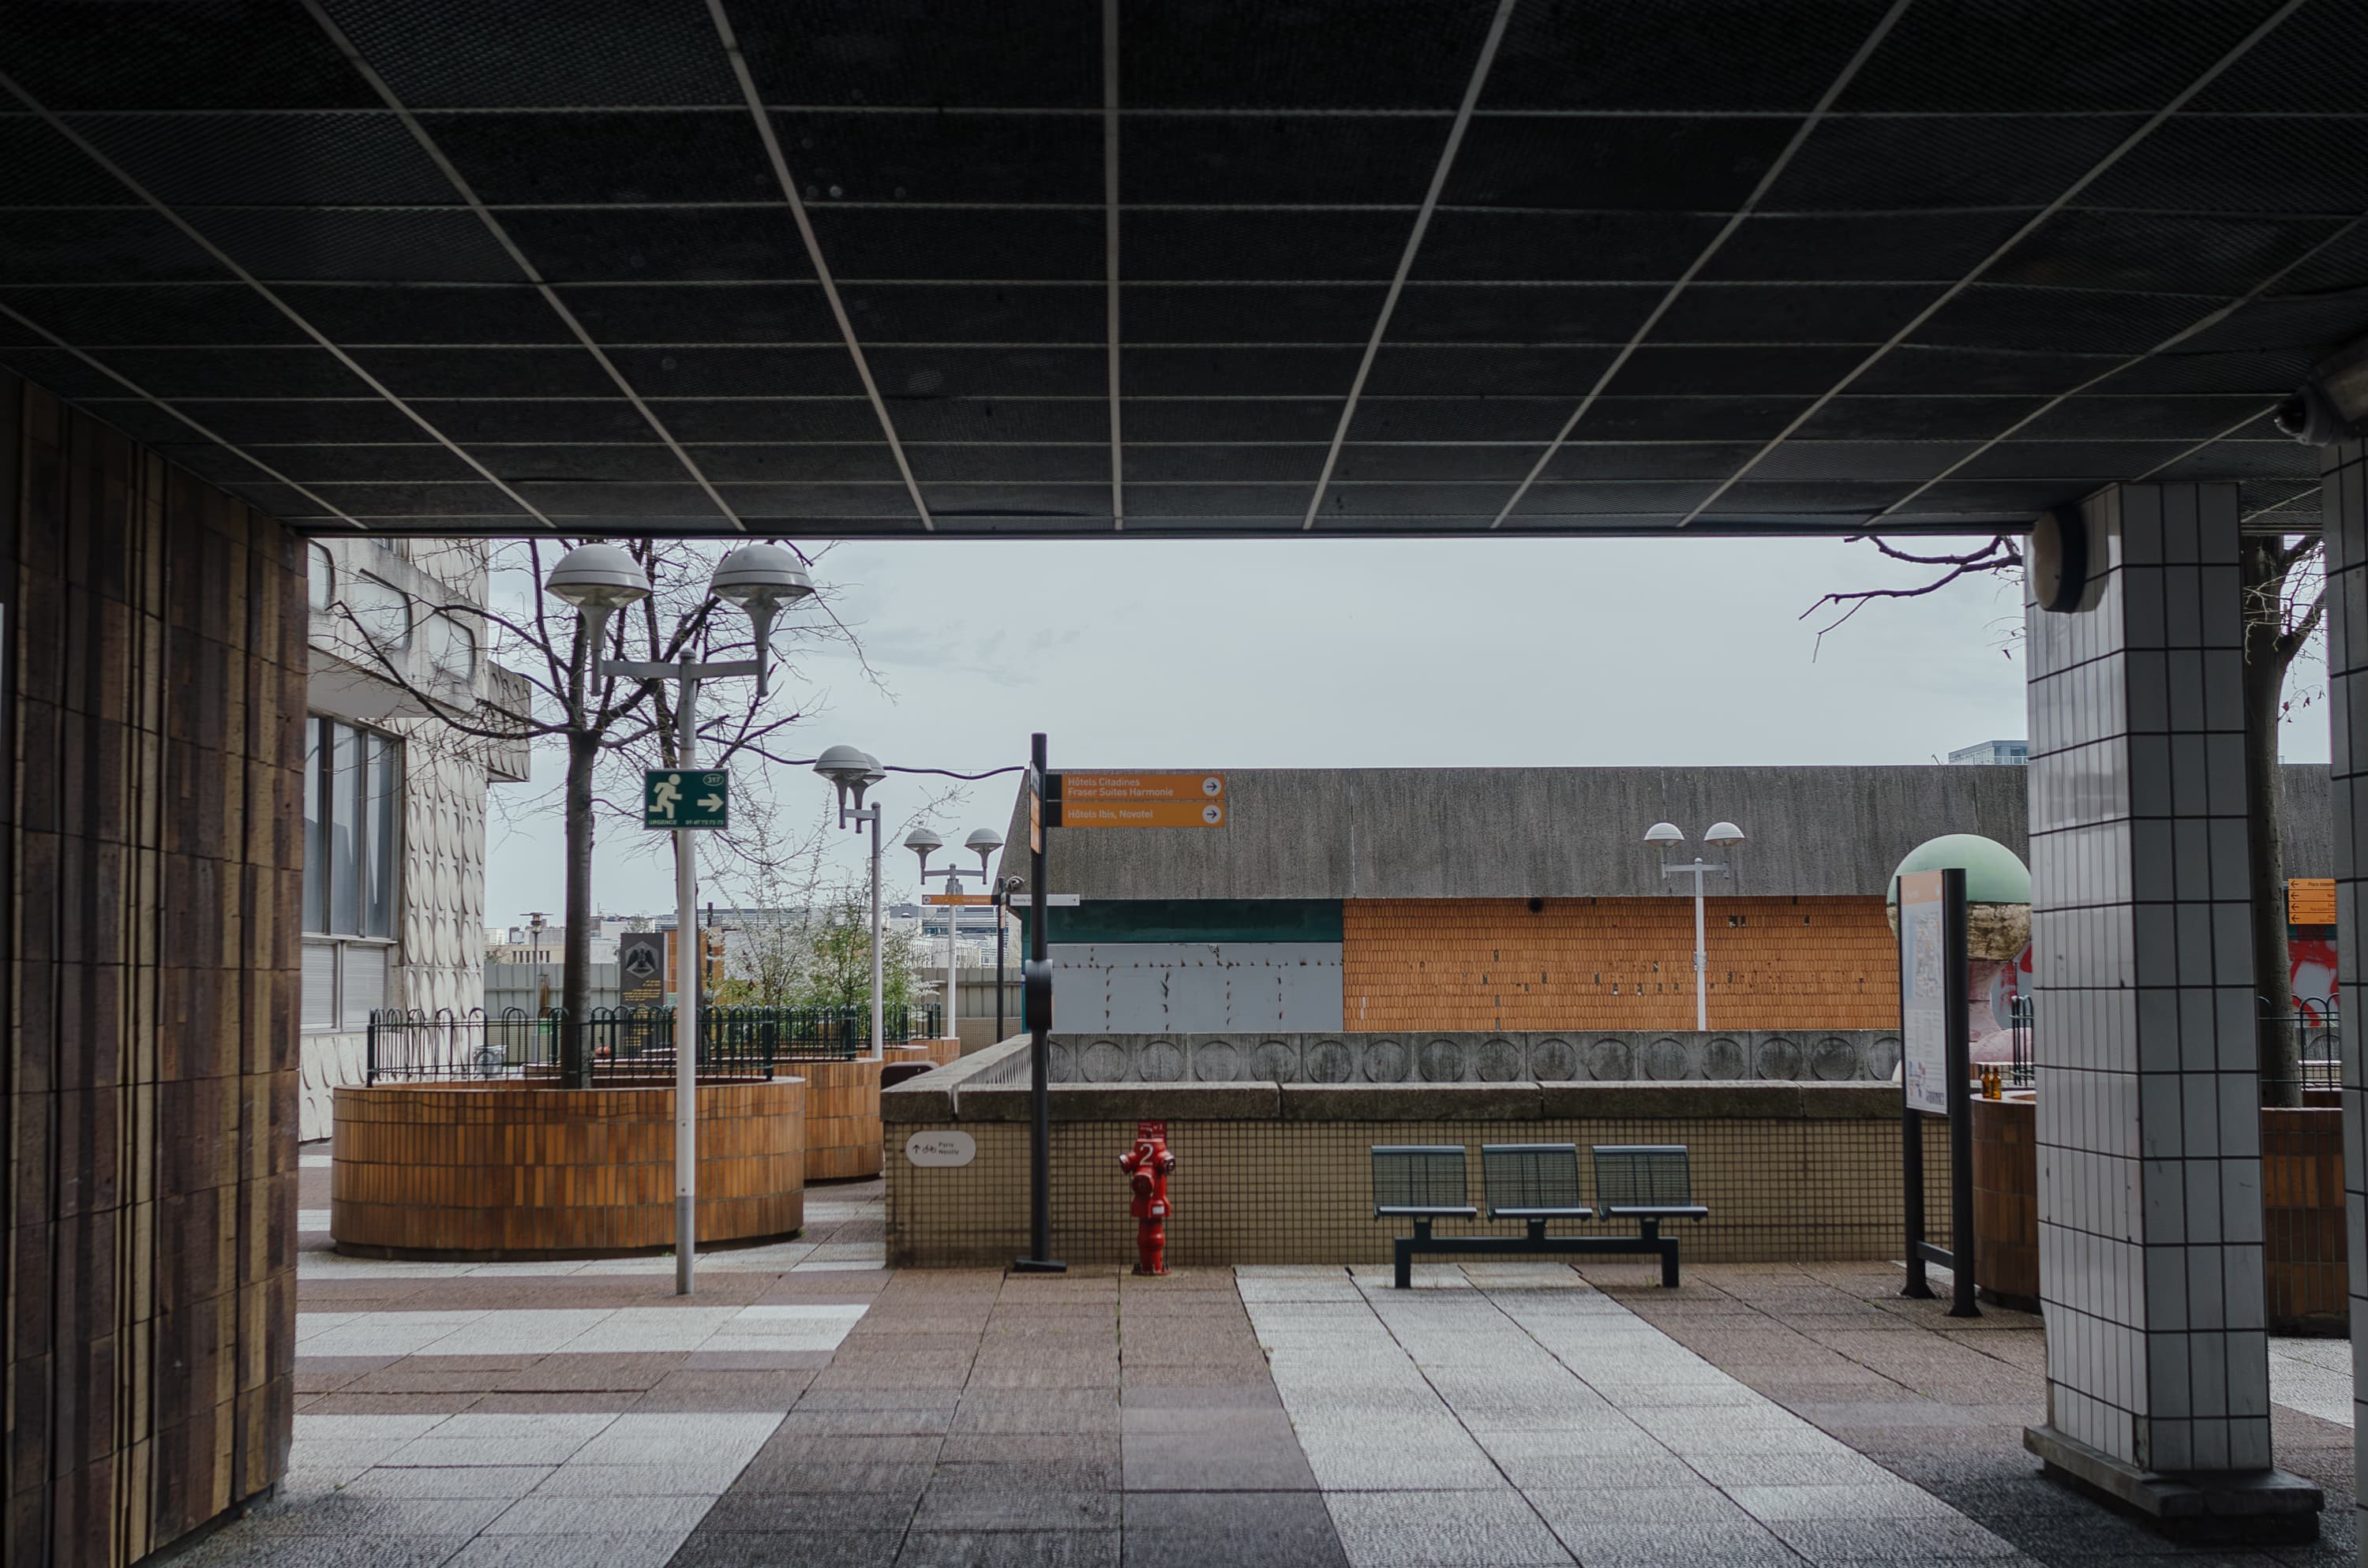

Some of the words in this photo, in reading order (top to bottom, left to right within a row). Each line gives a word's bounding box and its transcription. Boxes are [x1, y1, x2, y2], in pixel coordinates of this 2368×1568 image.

[1068, 777, 1097, 787] Hôtels
[1099, 777, 1141, 787] Citadines
[1068, 788, 1096, 796] Fraser
[1099, 788, 1127, 796] Suites
[1130, 788, 1174, 796] Harmonie
[1068, 810, 1097, 819] Hôtels
[1099, 810, 1117, 820] Ibis,
[1119, 810, 1154, 819] Novotel
[1140, 1143, 1154, 1166] 2
